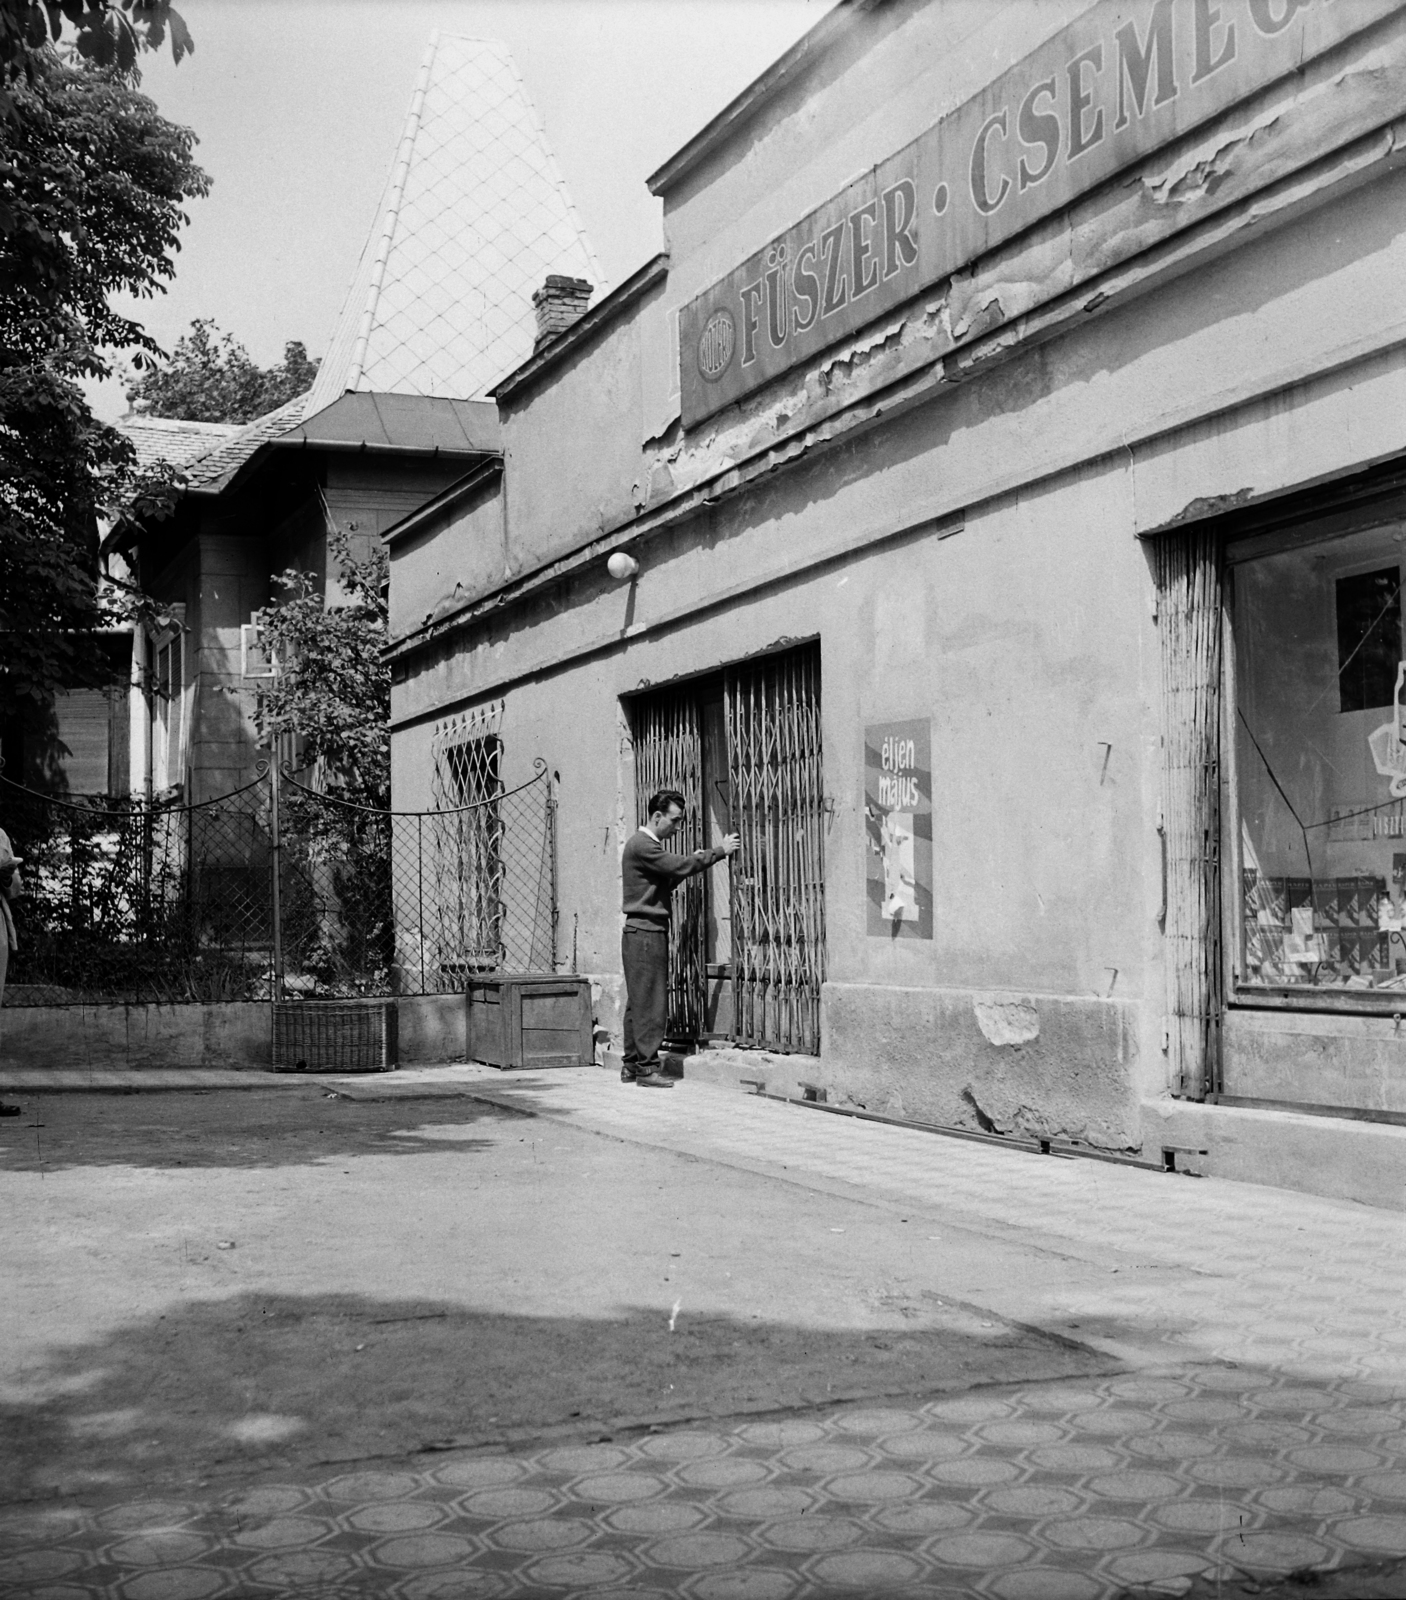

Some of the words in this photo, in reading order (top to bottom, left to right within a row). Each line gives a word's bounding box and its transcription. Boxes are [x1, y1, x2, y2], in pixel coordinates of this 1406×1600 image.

[740, 177, 918, 368] FÜSZER
[881, 736, 915, 773] éljen
[878, 772, 919, 811] május
